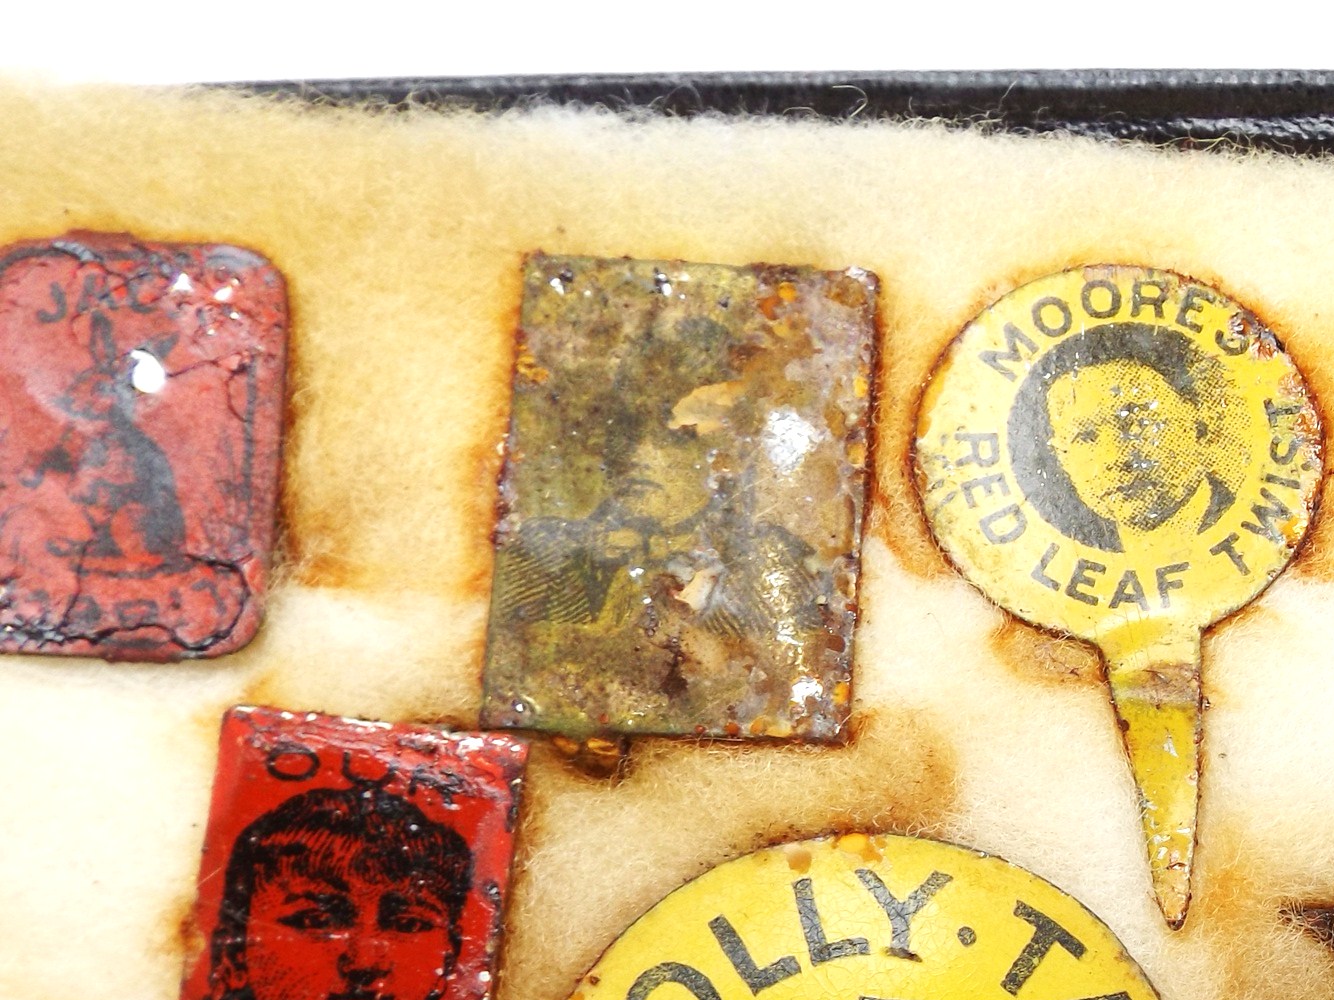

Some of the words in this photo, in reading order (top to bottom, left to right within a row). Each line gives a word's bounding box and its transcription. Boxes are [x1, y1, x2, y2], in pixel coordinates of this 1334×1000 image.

[953, 431, 1028, 545] RED
[1030, 542, 1191, 612] LEAF
[1209, 397, 1304, 578] TWIST
